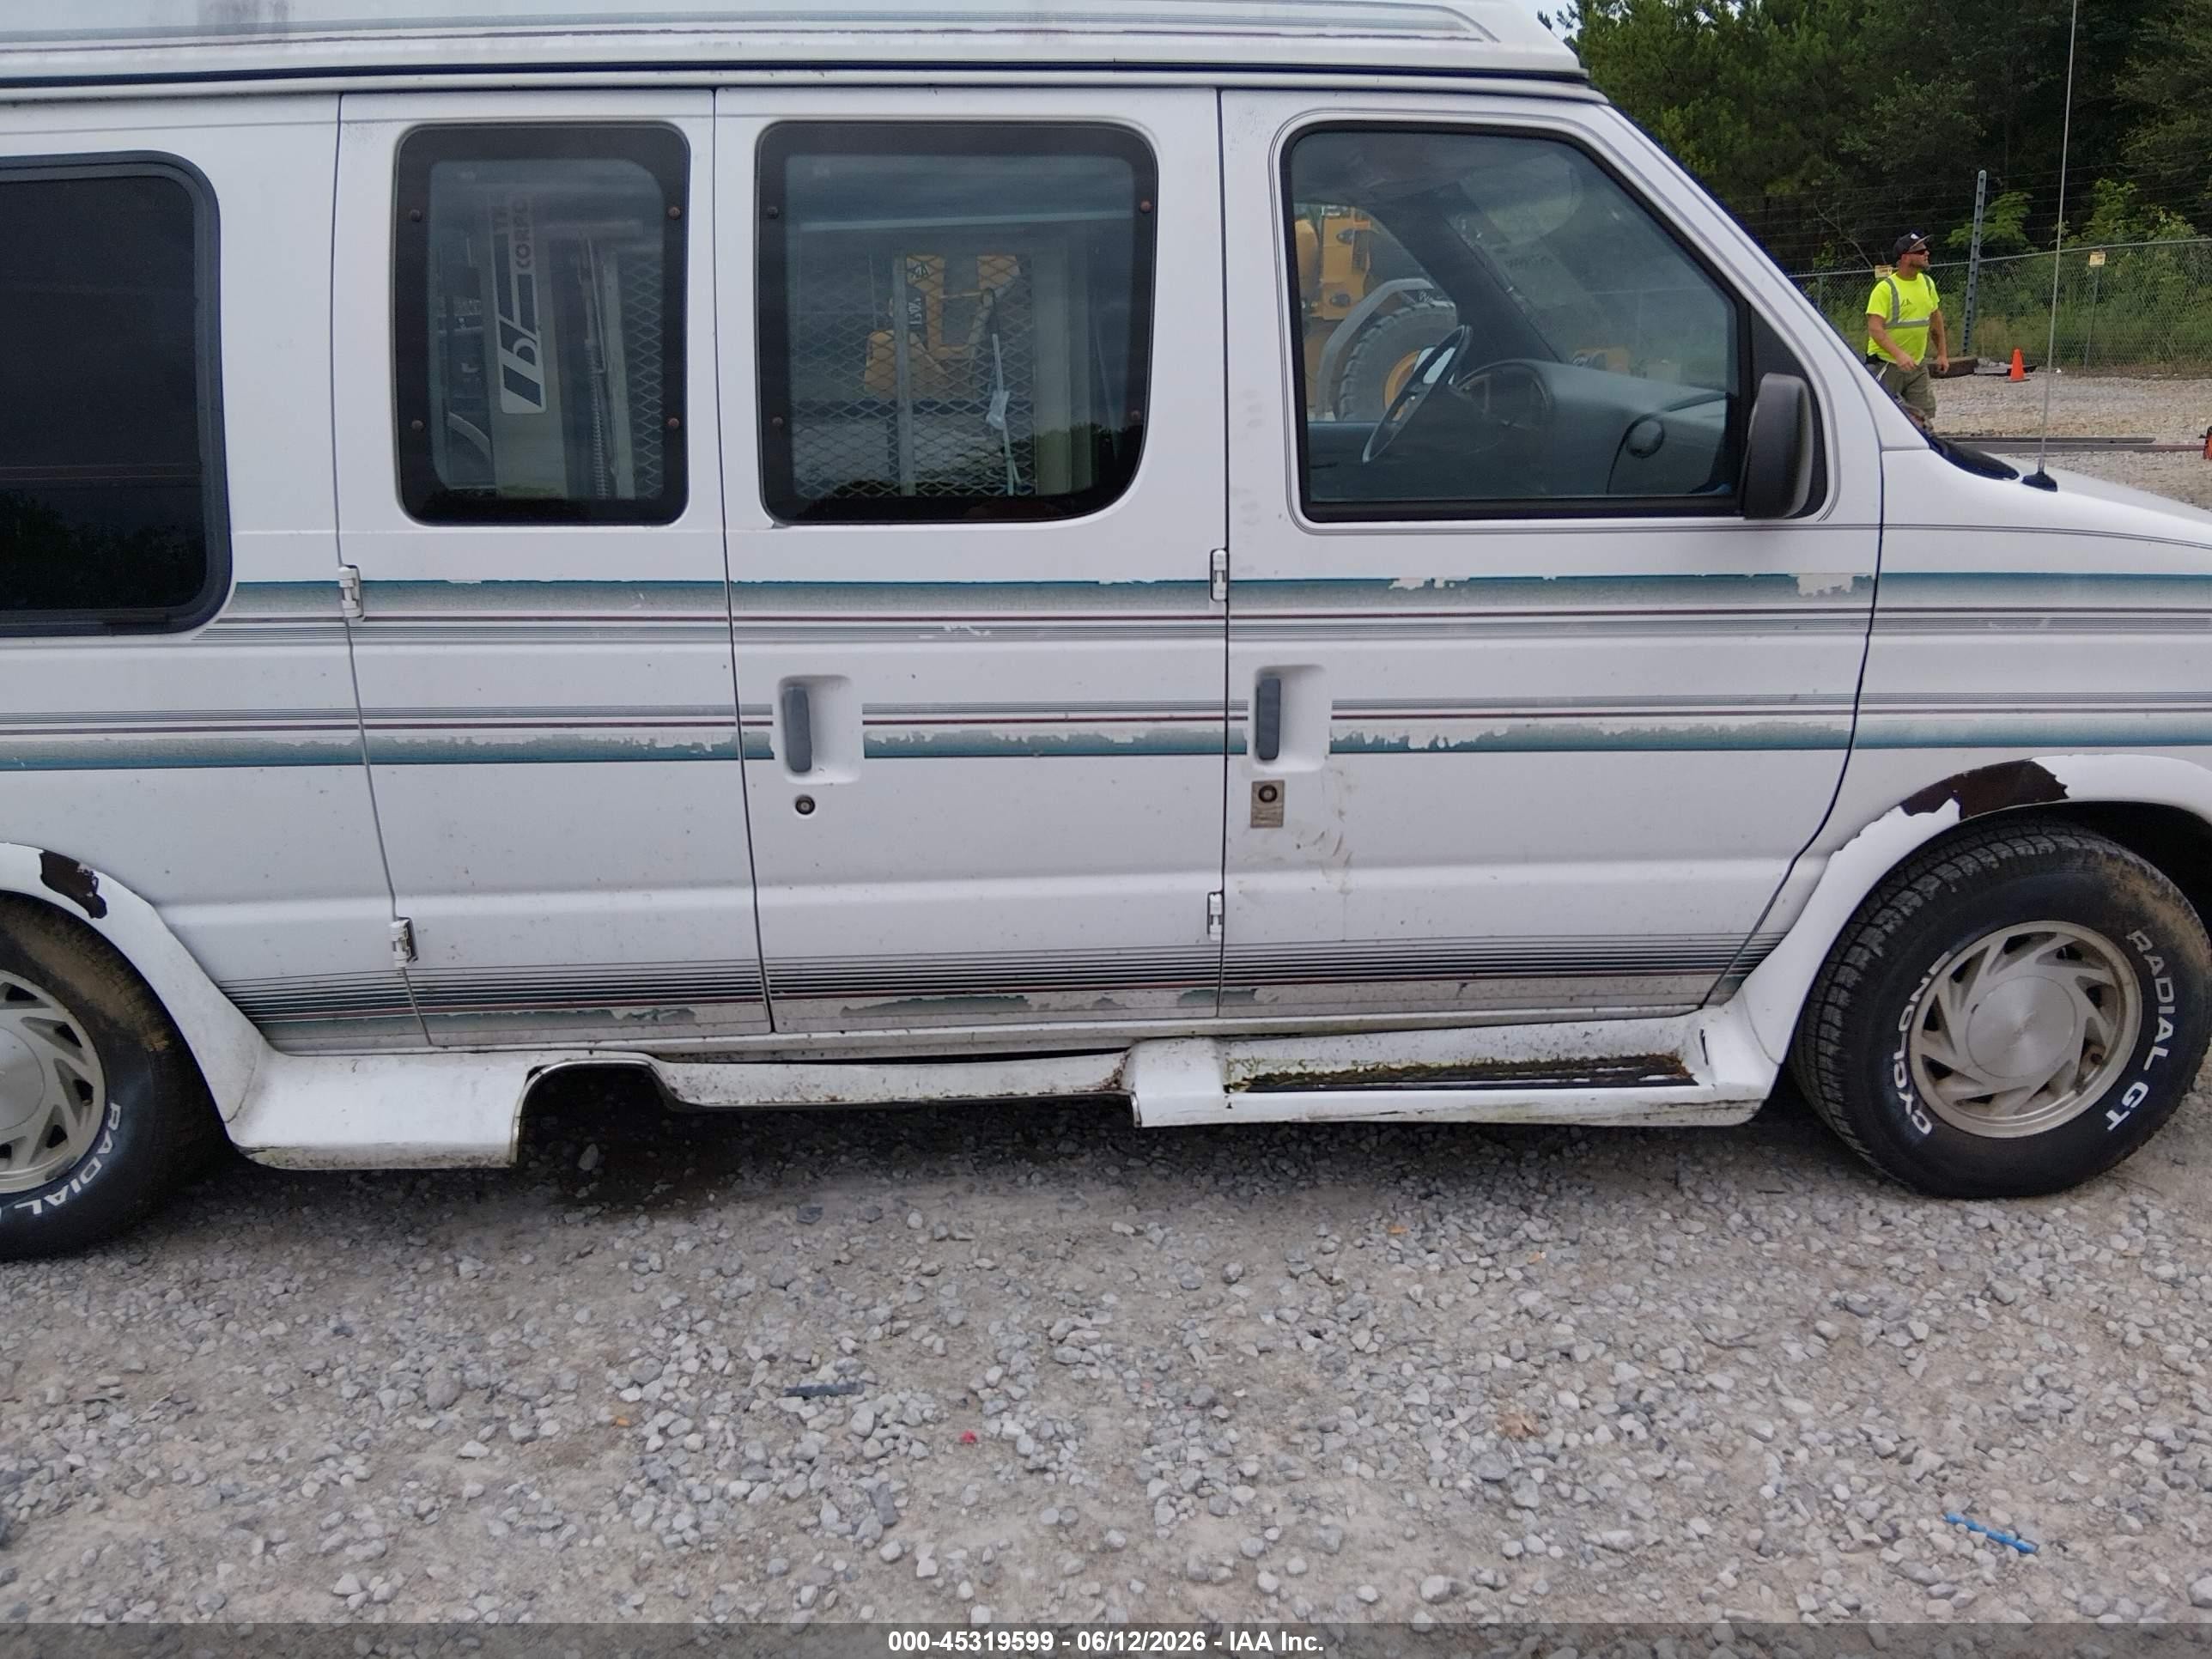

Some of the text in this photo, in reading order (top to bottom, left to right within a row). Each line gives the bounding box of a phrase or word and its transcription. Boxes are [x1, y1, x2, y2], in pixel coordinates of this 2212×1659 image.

[2106, 930, 2175, 1132] RADIAL GT
[14, 1103, 121, 1215] RADIAL
